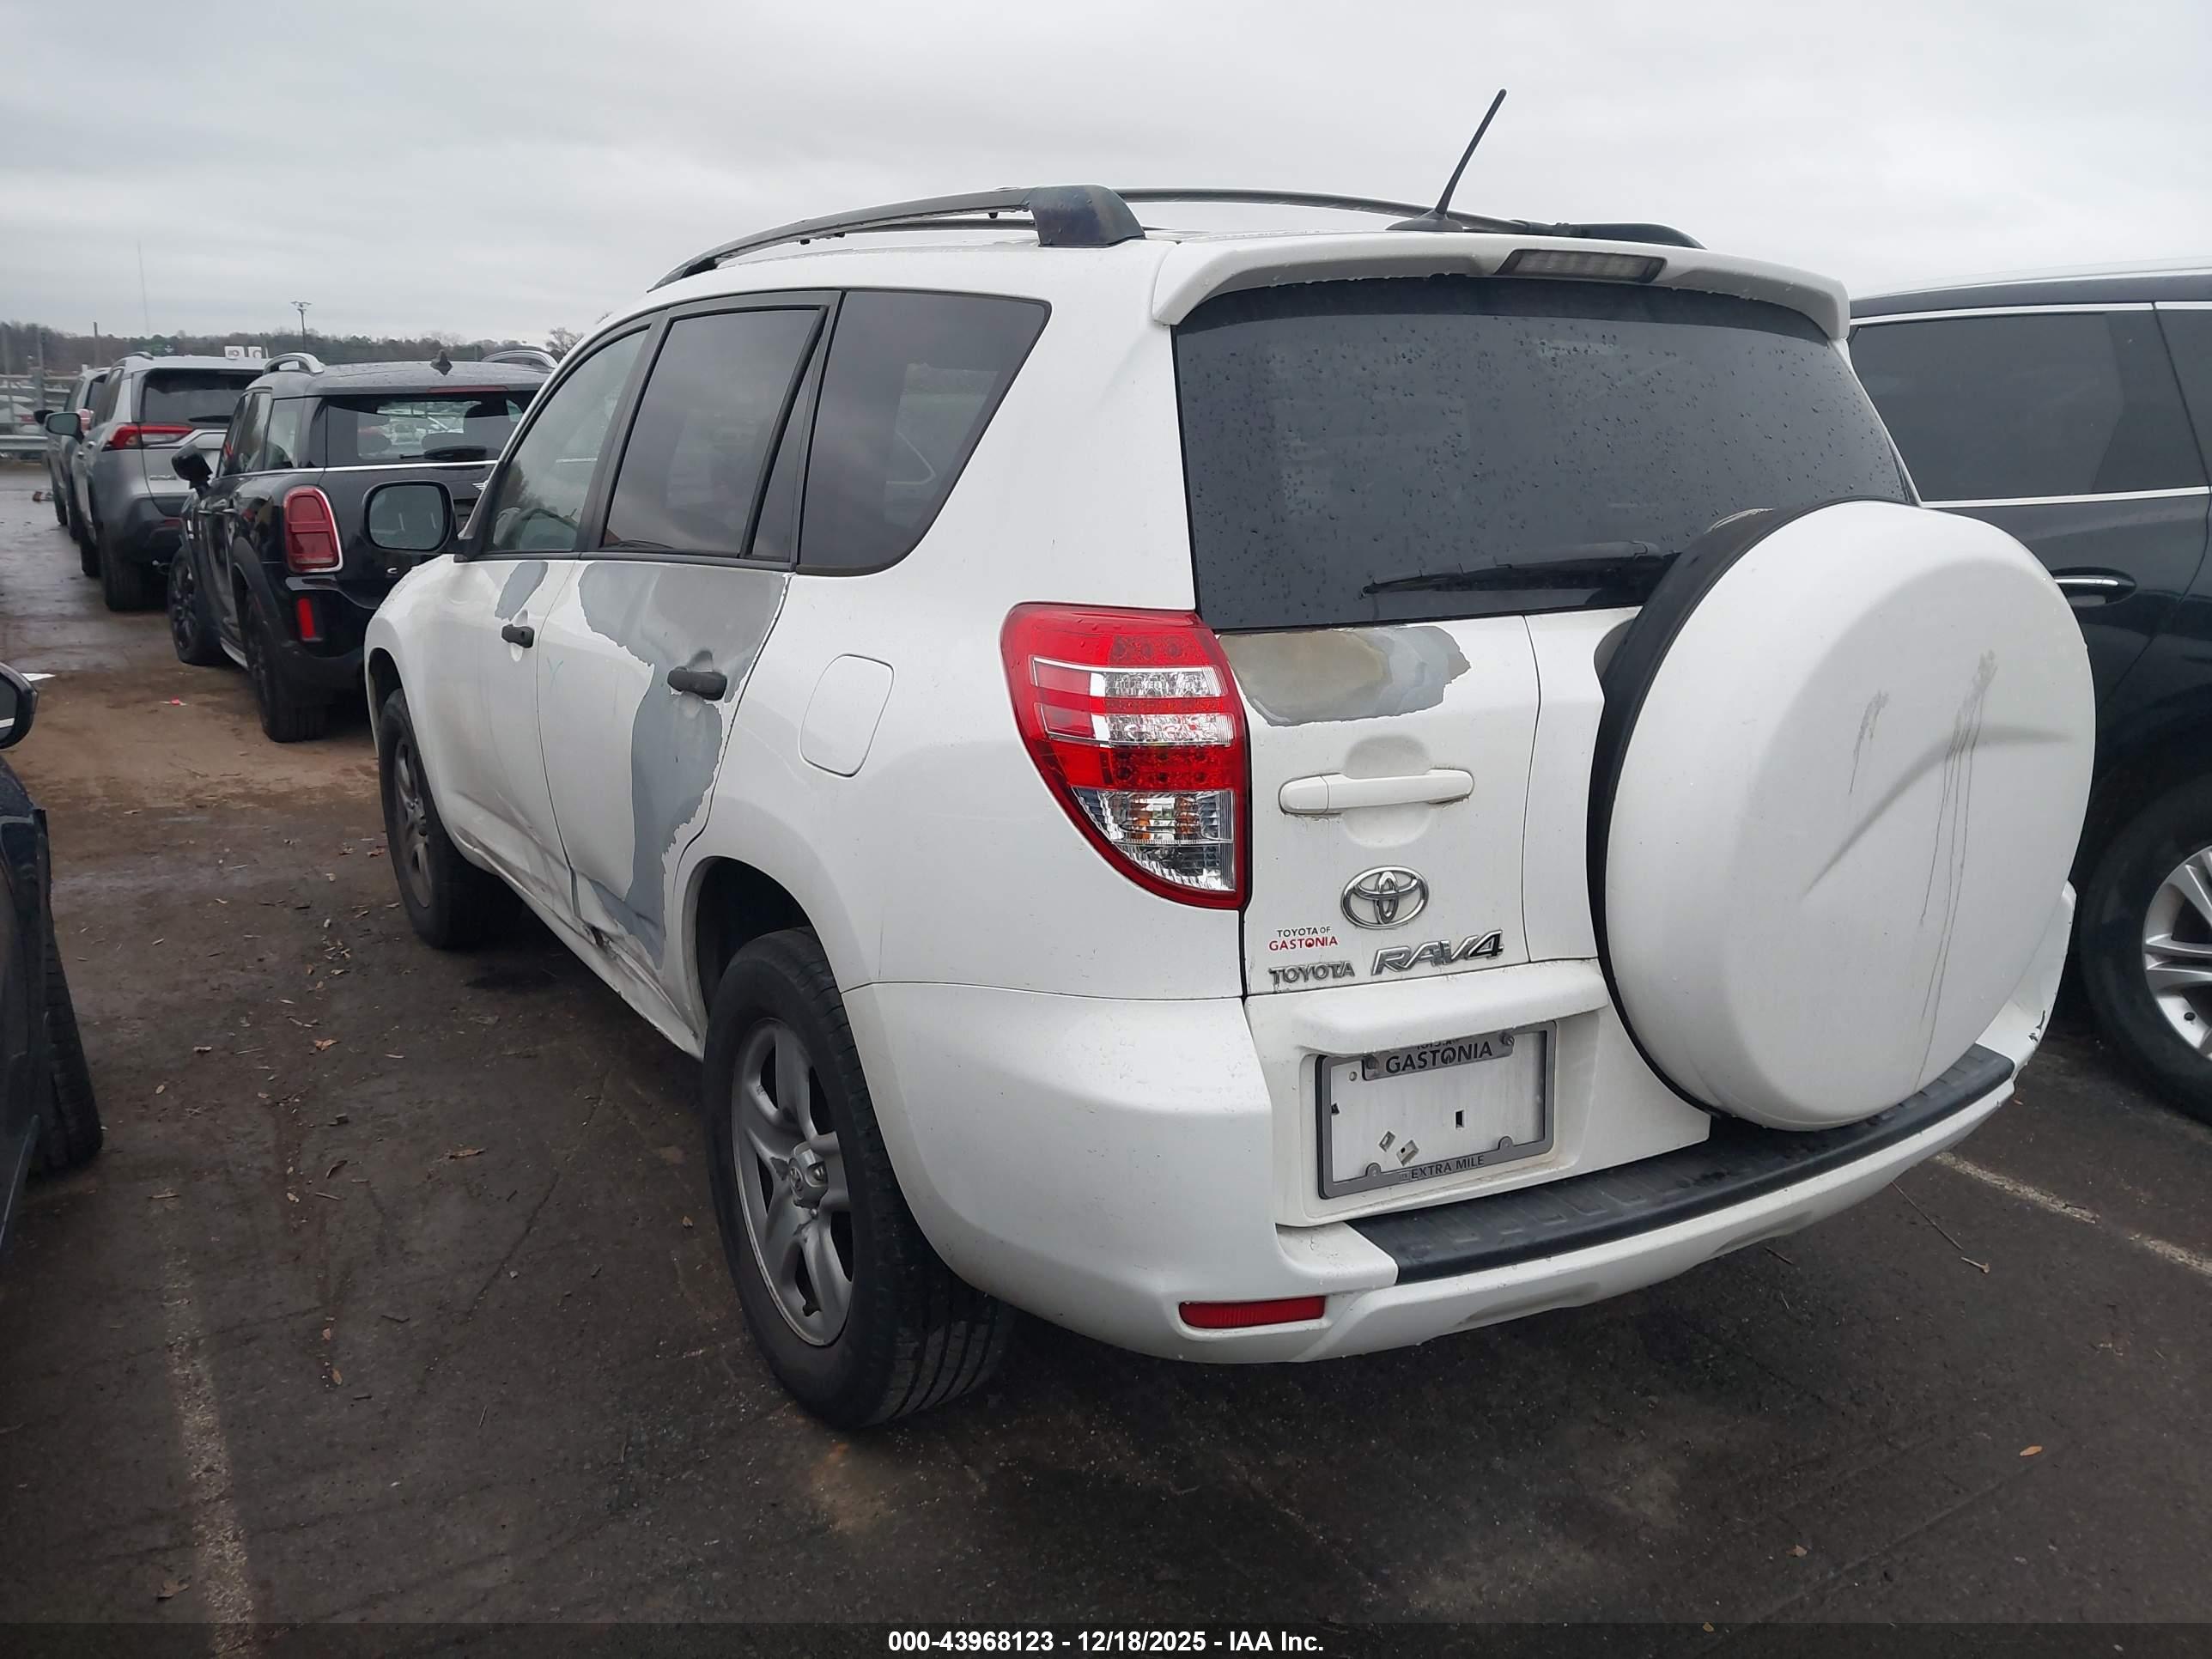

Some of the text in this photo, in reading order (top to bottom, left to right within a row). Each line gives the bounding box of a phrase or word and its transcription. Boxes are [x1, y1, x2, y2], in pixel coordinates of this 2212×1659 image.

[1268, 936, 1338, 951] GASTONIA
[1277, 926, 1331, 938] TOYOTA OF
[1268, 929, 1504, 985] TOYOTA RAV4
[1385, 1041, 1492, 1074] GASTONIA
[1411, 1162, 1452, 1179] EXTRA
[1455, 1154, 1485, 1170] MILE
